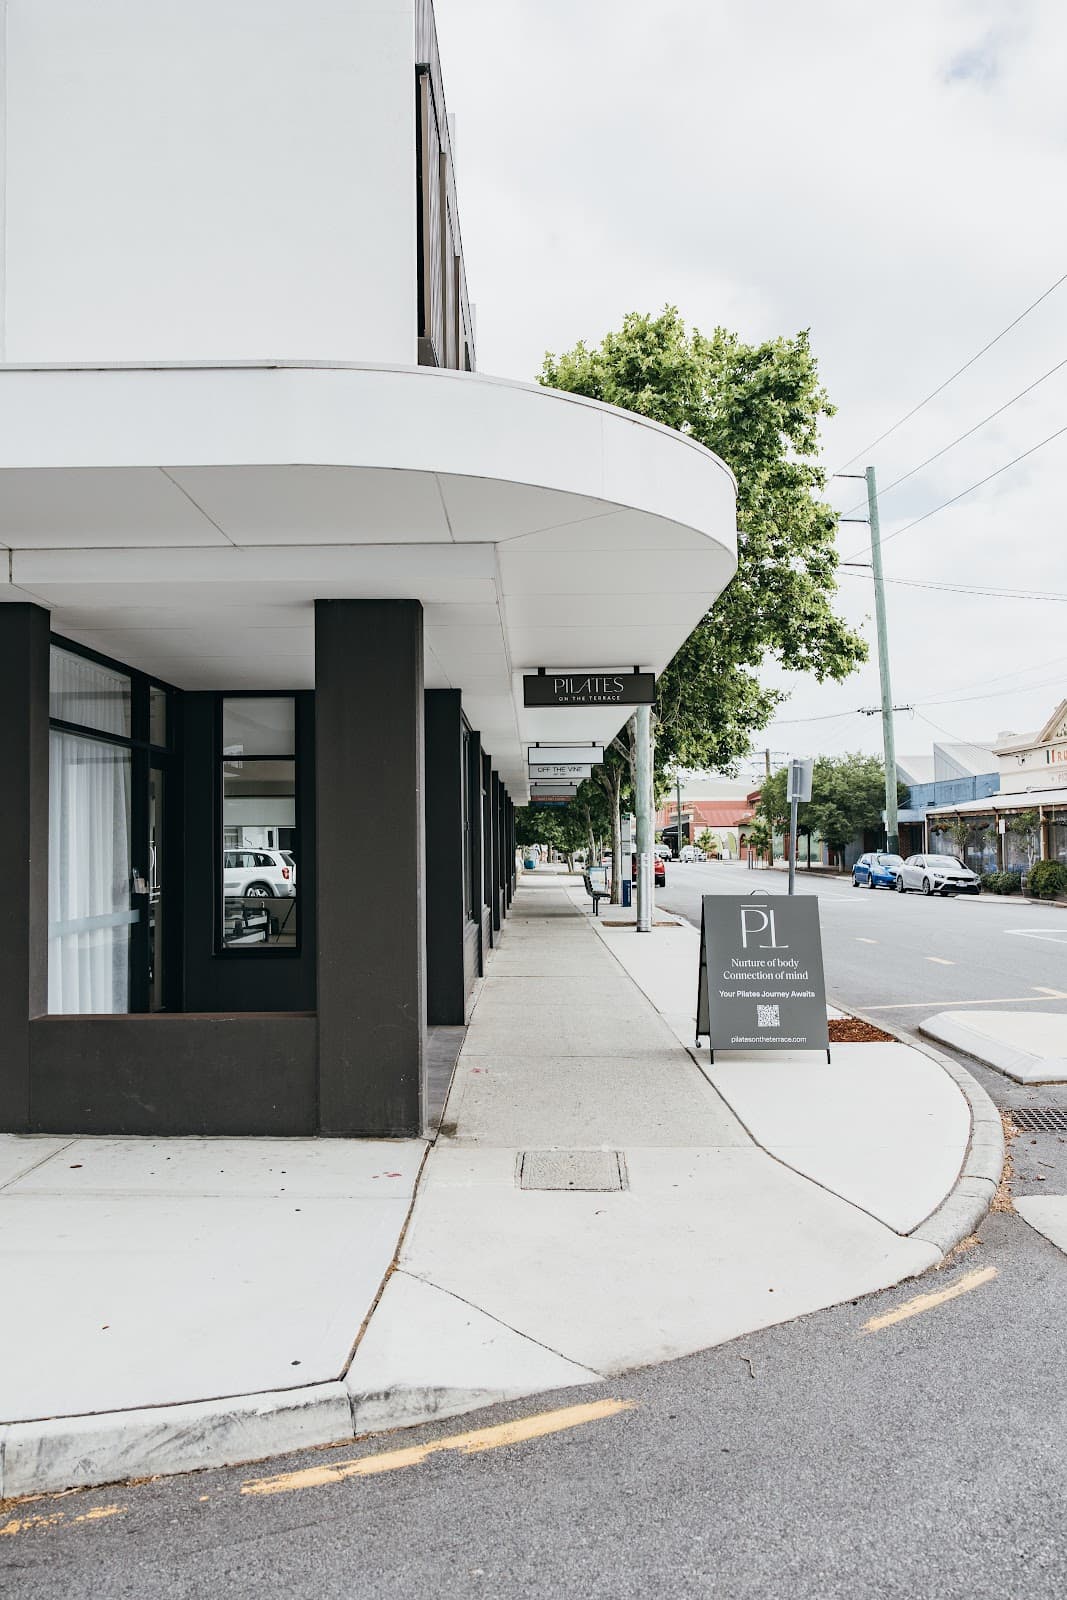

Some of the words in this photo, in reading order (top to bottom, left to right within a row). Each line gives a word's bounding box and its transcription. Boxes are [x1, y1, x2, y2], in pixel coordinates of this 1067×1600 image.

[554, 677, 624, 694] PILATES
[731, 958, 766, 967] Nurture
[766, 958, 777, 967] of
[777, 958, 800, 970] body
[723, 970, 774, 980] Connection
[774, 970, 785, 980] of
[785, 970, 809, 980] mind
[719, 990, 736, 998] Your
[736, 990, 761, 998] Pilates
[761, 990, 789, 999] Journey
[790, 990, 816, 998] Awaits
[731, 1035, 807, 1044] pilatesontheterrace.com
